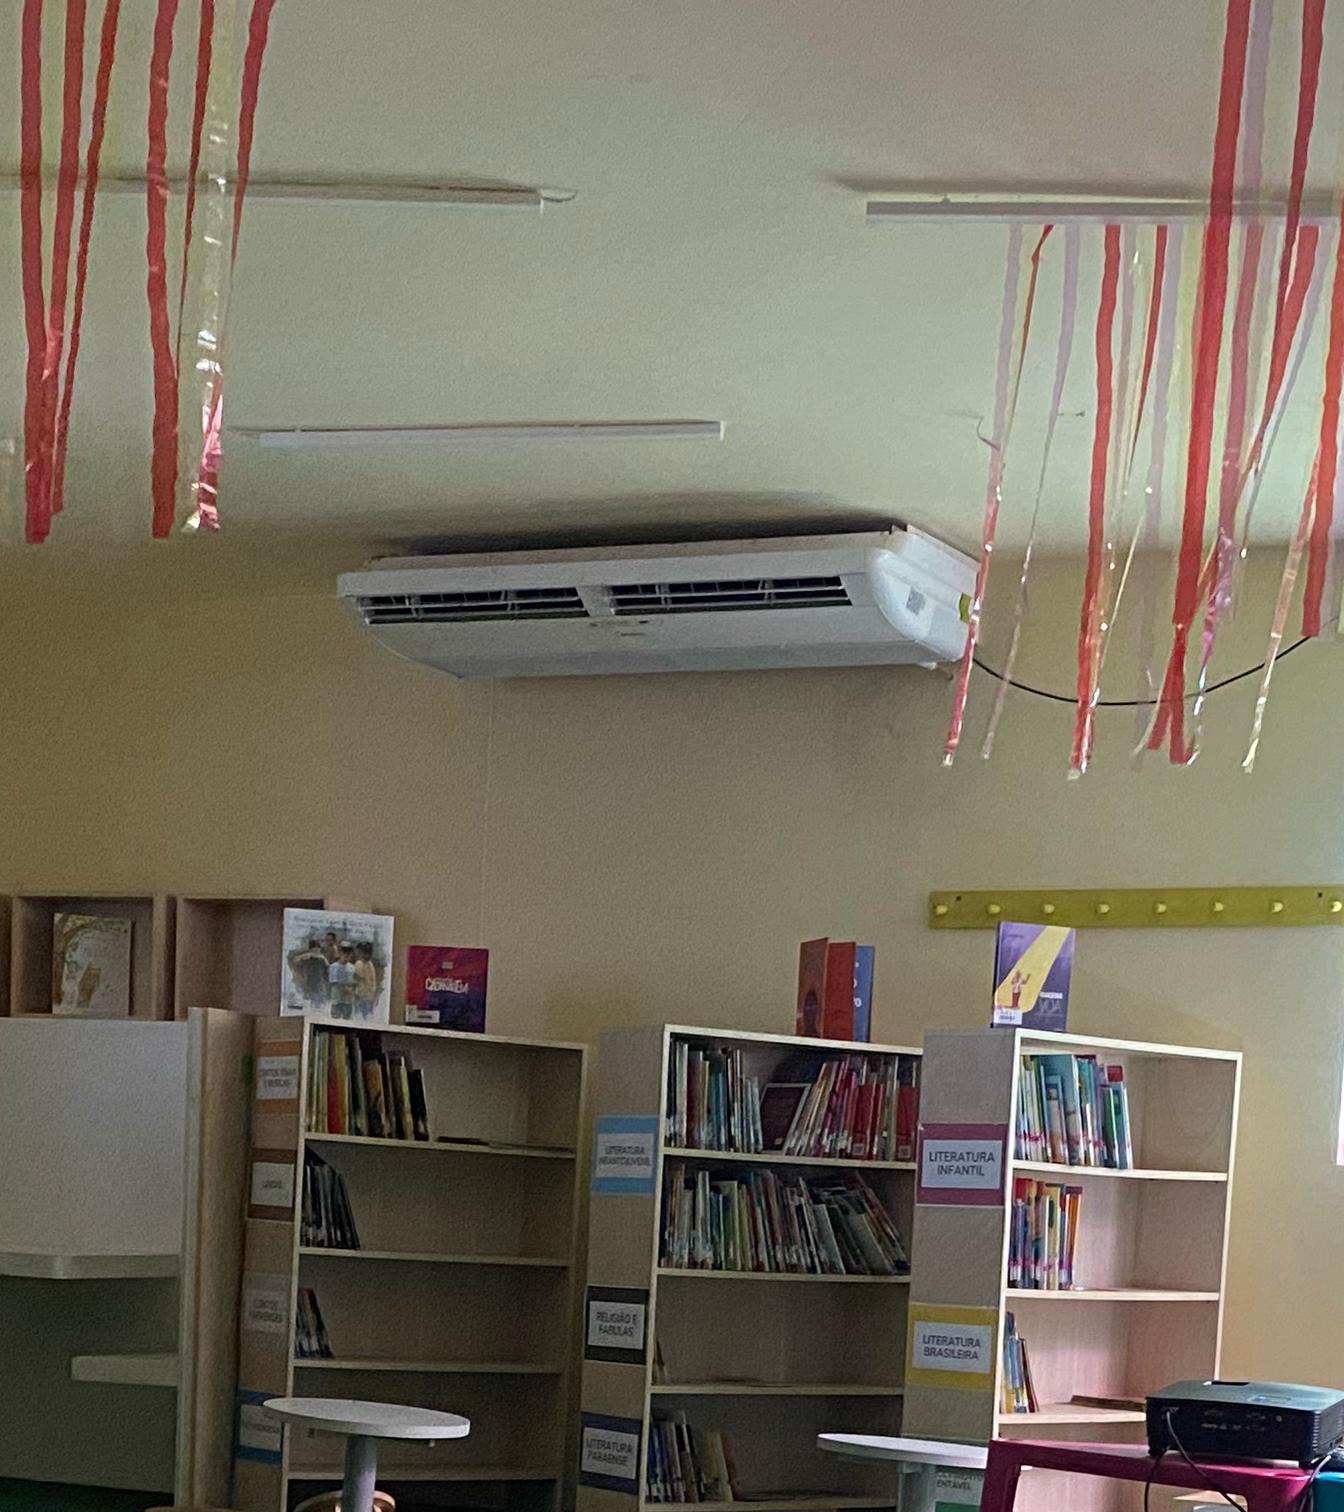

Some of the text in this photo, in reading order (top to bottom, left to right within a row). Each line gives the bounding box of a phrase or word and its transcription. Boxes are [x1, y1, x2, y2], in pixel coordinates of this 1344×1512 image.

[928, 1151, 995, 1162] LITERATURA
[937, 1164, 985, 1176] INFANTIL
[922, 1334, 981, 1348] LITERATURA
[923, 1347, 979, 1360] BRASILEIRA
